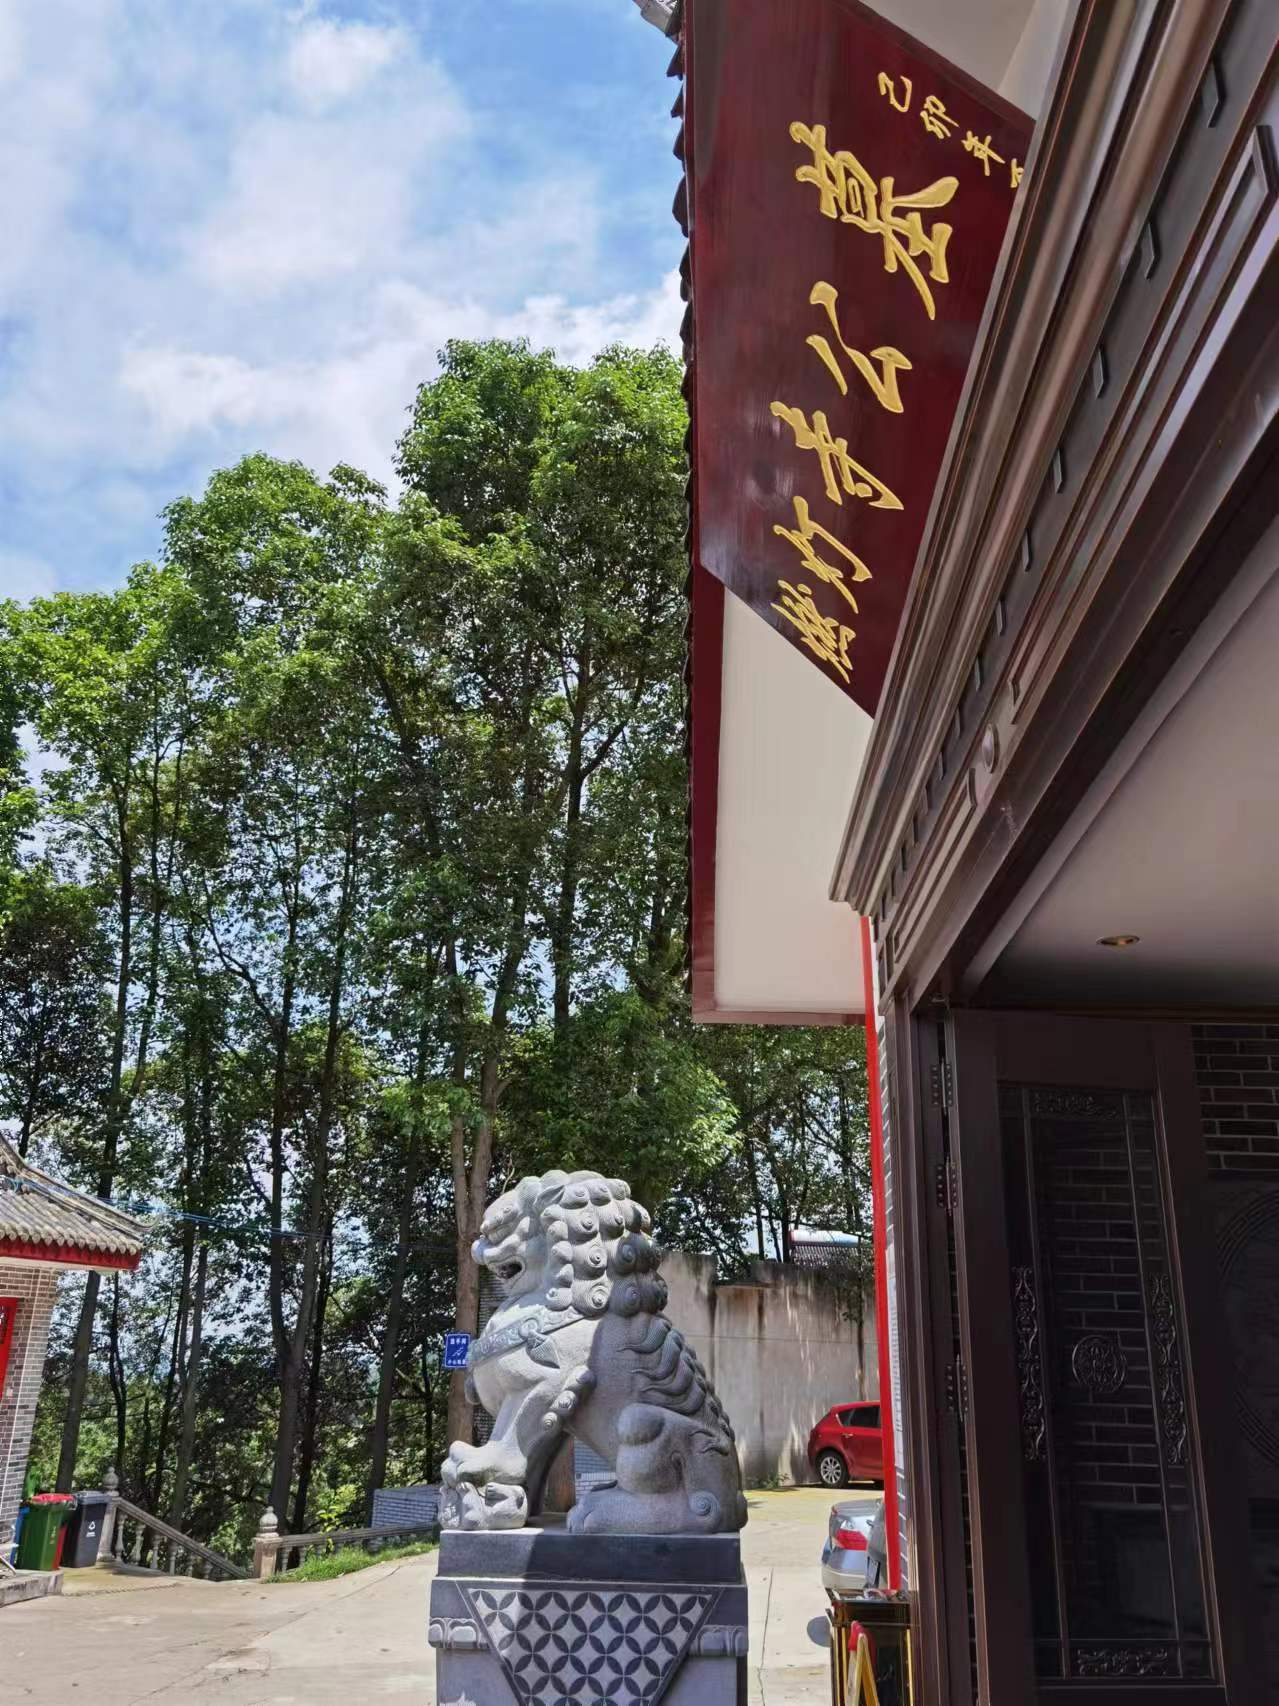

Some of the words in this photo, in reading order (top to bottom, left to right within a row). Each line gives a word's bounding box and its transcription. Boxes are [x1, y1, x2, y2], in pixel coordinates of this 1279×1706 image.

[769, 120, 960, 685] 燃灯寺公墓
